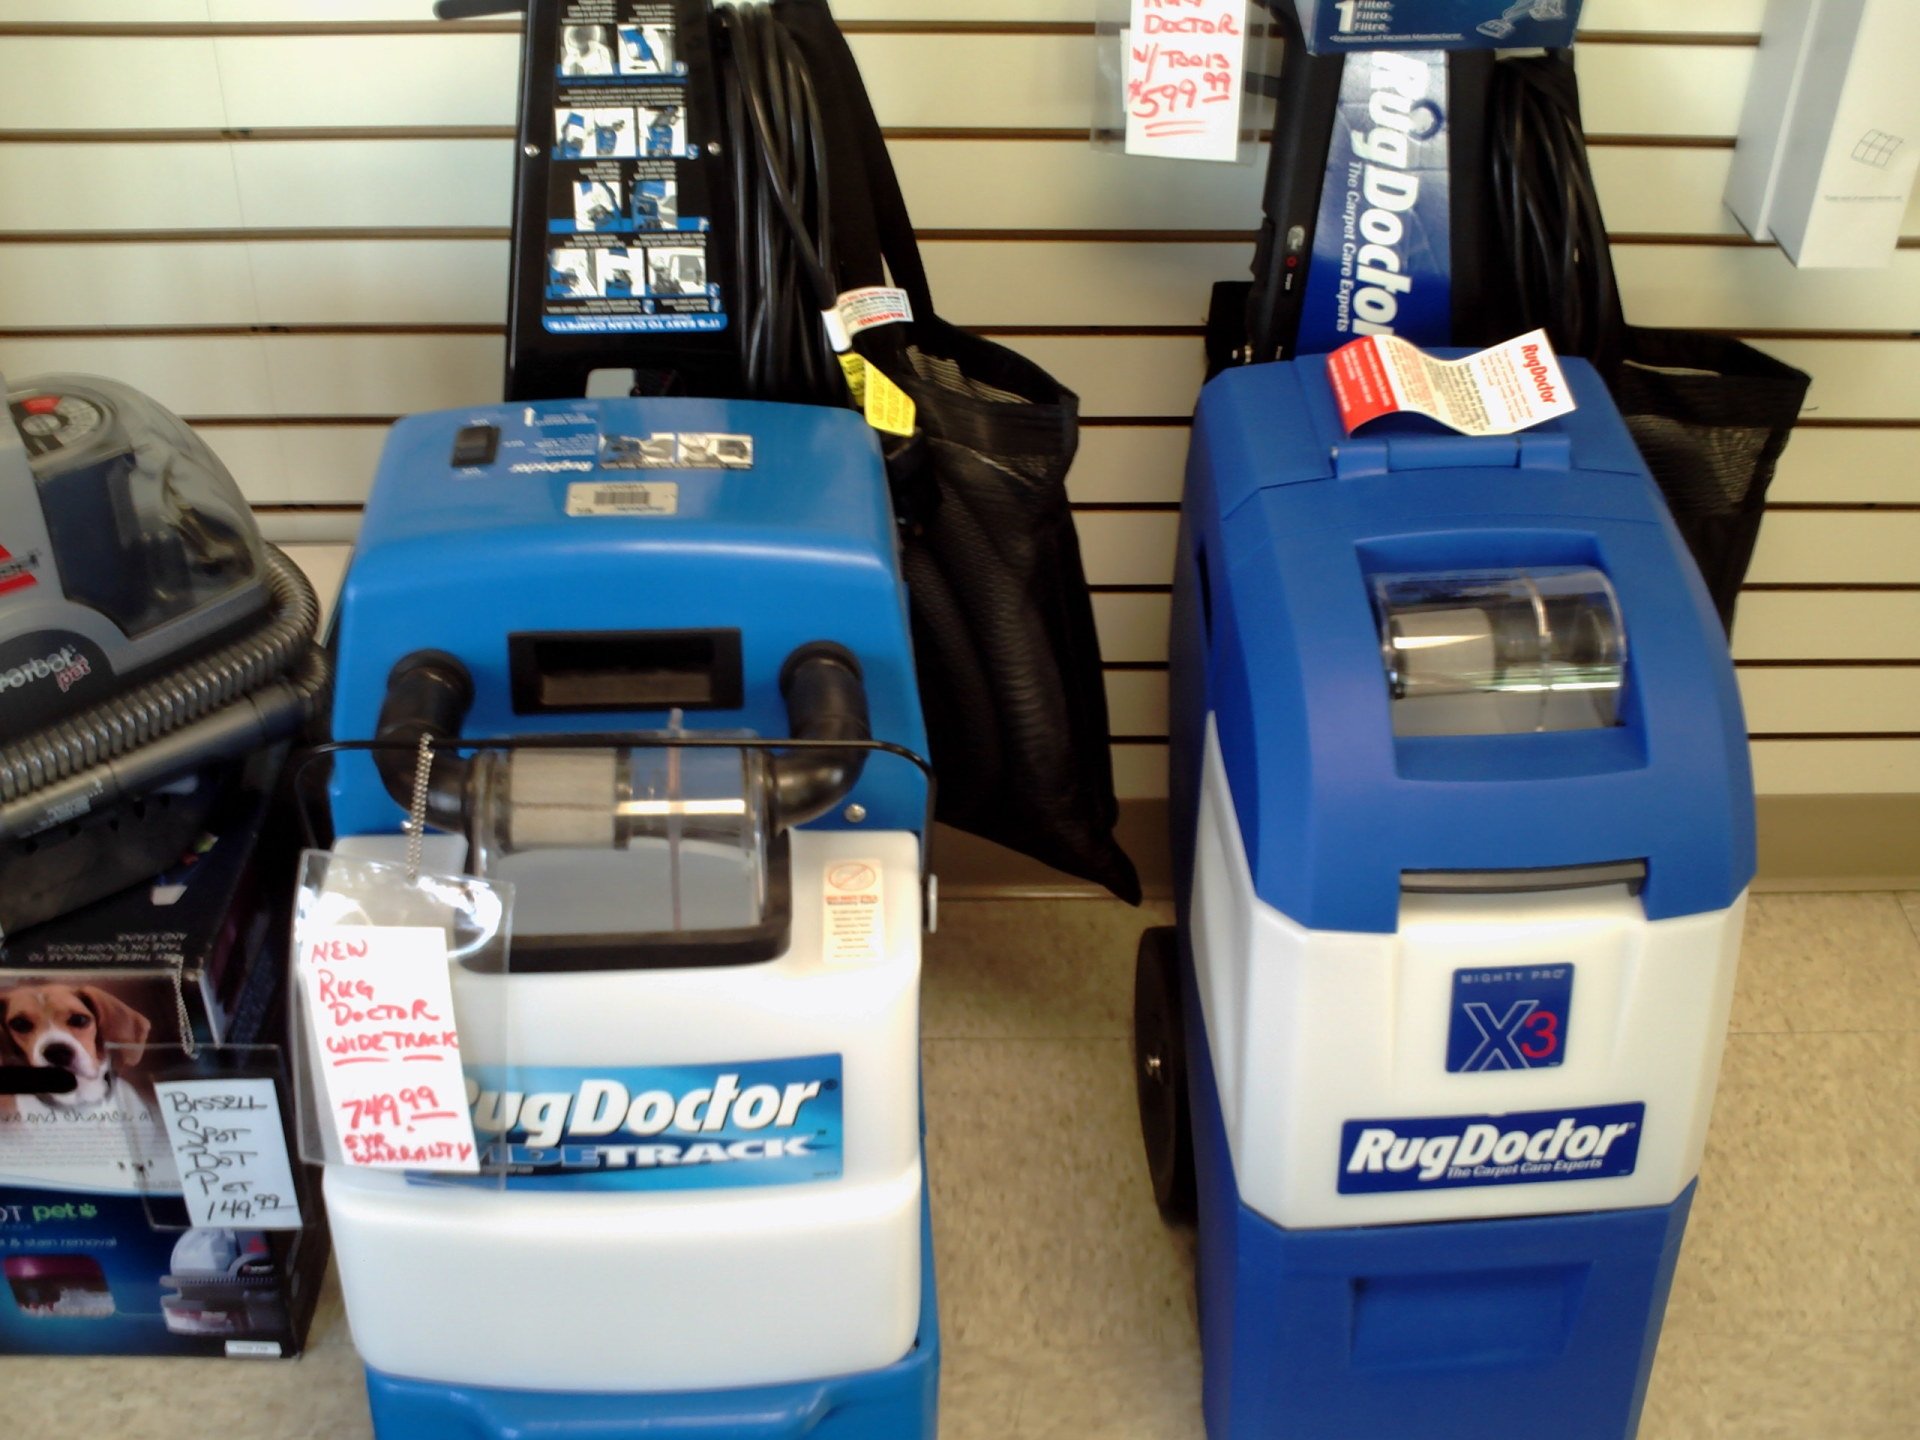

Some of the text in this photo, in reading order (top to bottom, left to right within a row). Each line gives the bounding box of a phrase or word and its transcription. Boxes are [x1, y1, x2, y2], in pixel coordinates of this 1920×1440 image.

[1335, 0, 1355, 33] 1
[1336, 161, 1362, 333] The Carpet Care Experts
[1521, 344, 1557, 403] RugDoctor
[311, 939, 368, 963] NEW
[1461, 969, 1562, 984] MIGHTY PRO
[1459, 999, 1558, 1073] X3
[1346, 1117, 1631, 1182] RugDoctor
[1447, 1165, 1472, 1179] The
[1473, 1163, 1518, 1179] Carpet
[1520, 1160, 1552, 1174] Care
[1554, 1157, 1603, 1173] Experts
[32, 1202, 78, 1222] pet
[60, 1236, 118, 1248] removal
